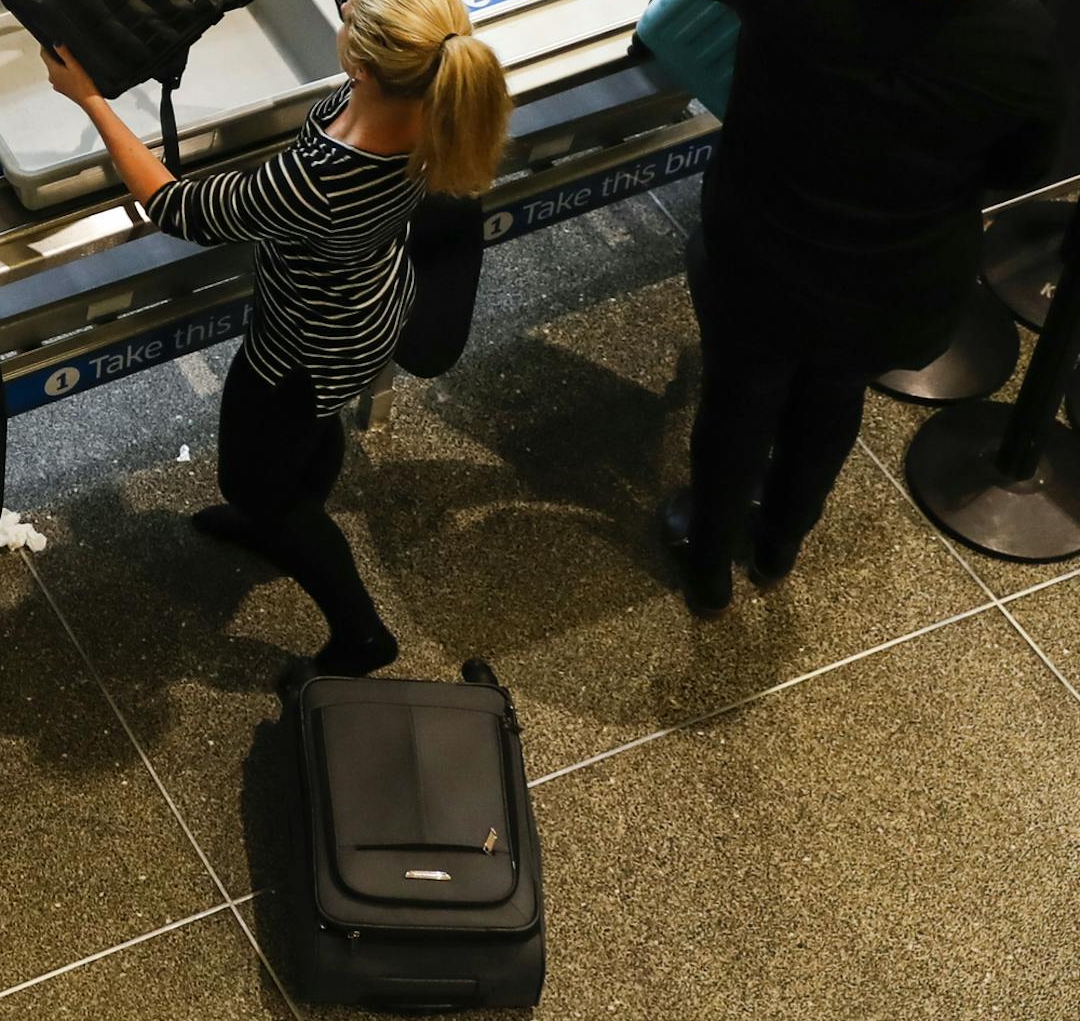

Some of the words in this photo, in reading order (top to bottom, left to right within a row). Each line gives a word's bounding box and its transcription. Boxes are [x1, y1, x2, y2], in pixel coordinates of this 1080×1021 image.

[522, 186, 592, 225] Take
[601, 164, 656, 197] this
[665, 144, 713, 175] bin
[88, 340, 163, 379] Take
[173, 314, 232, 349] this
